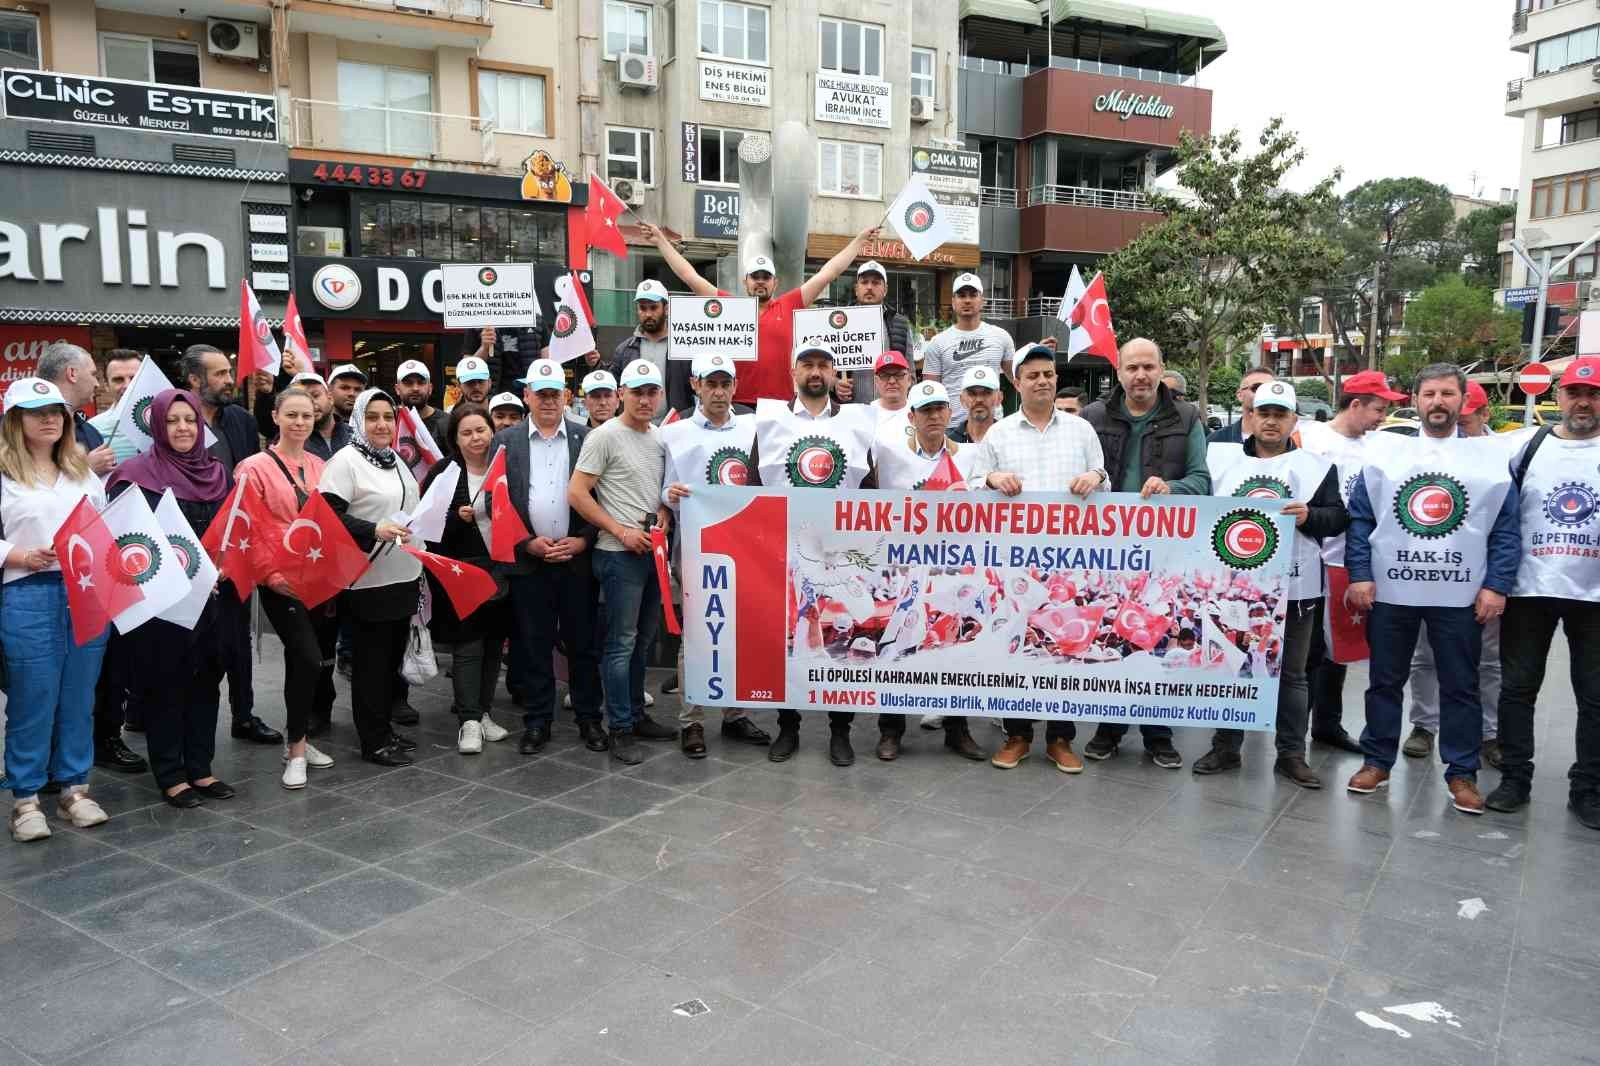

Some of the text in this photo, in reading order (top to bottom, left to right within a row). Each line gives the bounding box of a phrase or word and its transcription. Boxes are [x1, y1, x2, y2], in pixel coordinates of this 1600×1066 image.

[705, 81, 730, 91] ENES
[832, 91, 876, 106] AVUKAT
[1095, 89, 1174, 120] Mutfaktan
[73, 108, 190, 131] GÜZELLİK MERKEZİ
[959, 156, 978, 169] TUR
[313, 163, 427, 190] 444 33 67
[462, 292, 477, 300] KHK
[671, 322, 756, 334] YAŞASIN 1 MAYIS
[673, 334, 754, 347] YAŞASIN HAK-İŞ
[843, 331, 877, 342] ÜCRET
[958, 338, 984, 351] NIKE
[830, 343, 863, 354] NİDEN
[835, 496, 1197, 539] HAK-İŞ KONFEDERASYONU
[1532, 531, 1544, 545] ÖZ
[887, 539, 1151, 575] MANİSA İL BAŞKANLIĞI
[1397, 548, 1462, 567] HAK-İŞ
[1387, 566, 1471, 583] GÖREVLİ
[700, 495, 788, 703] 1
[702, 564, 728, 700] MAYIS
[808, 666, 824, 683] ELİ
[828, 666, 872, 684] ÖPÜLESİ
[875, 669, 938, 686] KAHRAMAN
[941, 671, 1029, 691] EMEKÇİLERİMİZ,
[1032, 674, 1058, 691] YENİ
[1061, 675, 1080, 692] BİR
[1083, 676, 1122, 694] DÜNYA
[1155, 681, 1192, 698] ETMEK
[1196, 682, 1258, 701] HEDEFİMİZ
[750, 689, 774, 699] 2022
[808, 690, 1256, 724] 1 MAYIS Uluslararası Birlik, Mücadele ve Dayanışma Günümüz Kutlu Olsun
